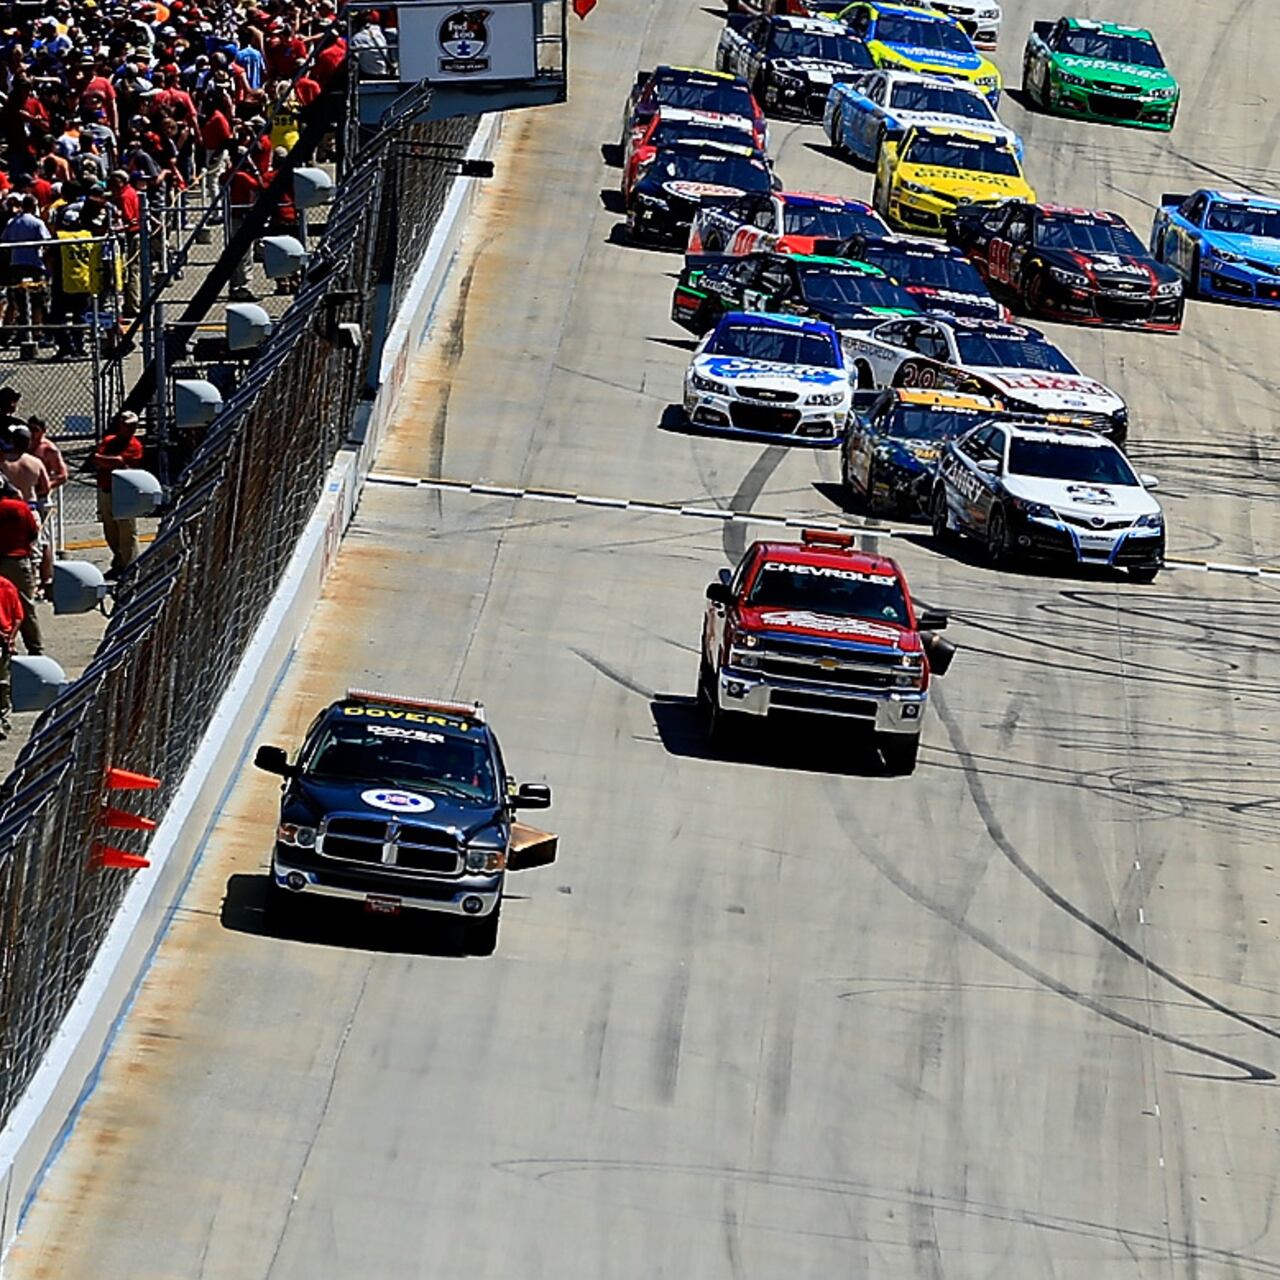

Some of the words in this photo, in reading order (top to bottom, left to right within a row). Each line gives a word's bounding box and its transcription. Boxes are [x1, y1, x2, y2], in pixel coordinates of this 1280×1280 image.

[1085, 260, 1149, 277] reddit
[764, 562, 896, 587] CHEVROLET
[367, 725, 445, 744] DOVER
